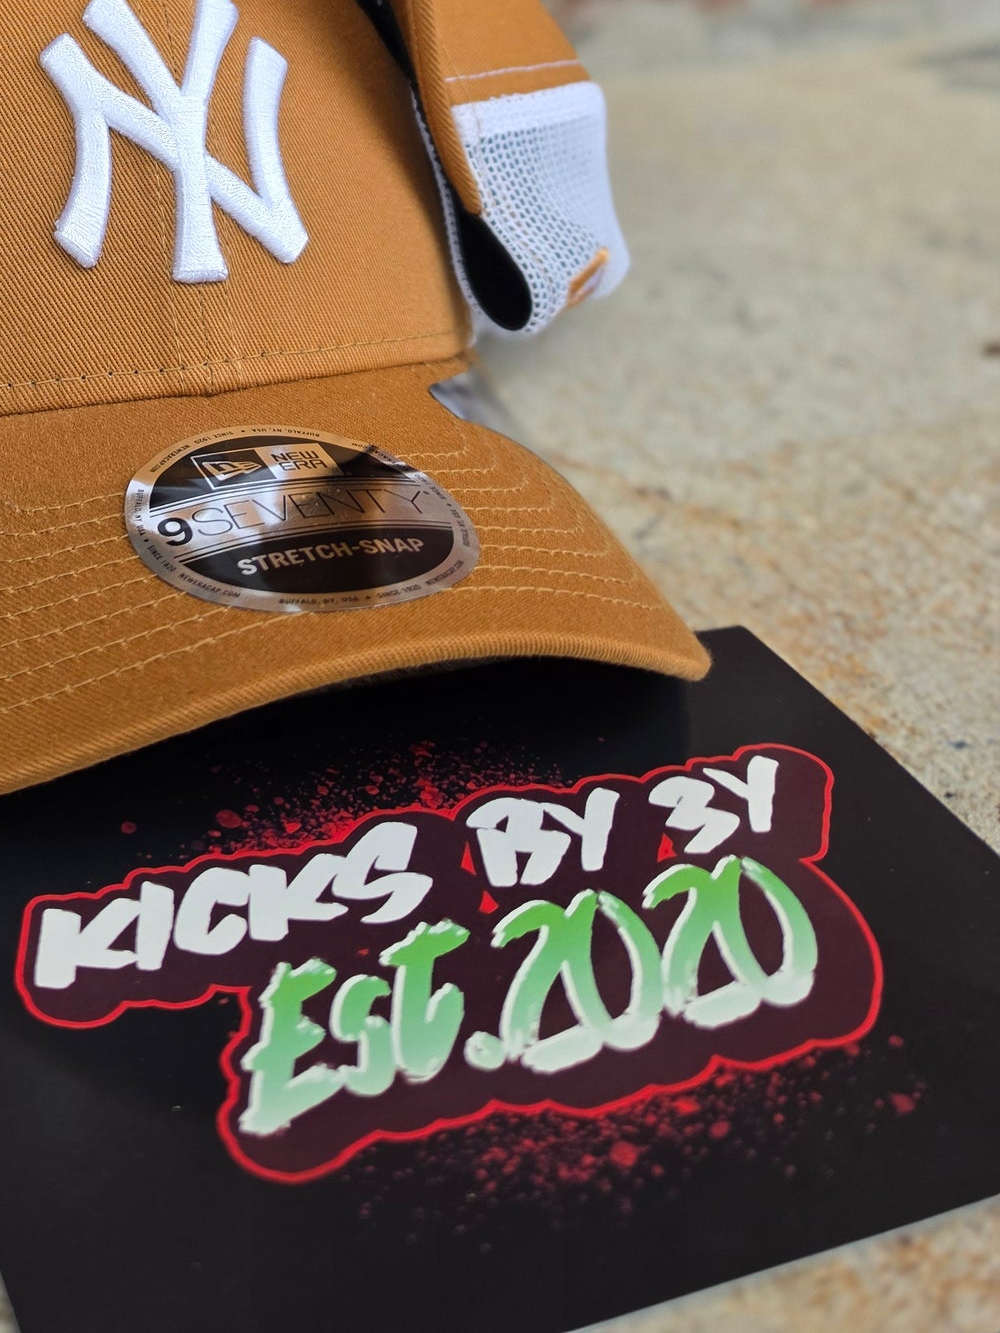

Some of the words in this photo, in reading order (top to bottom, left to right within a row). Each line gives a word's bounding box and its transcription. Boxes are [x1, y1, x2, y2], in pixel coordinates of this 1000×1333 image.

[271, 450, 319, 463] NEW
[279, 459, 328, 471] ERA
[236, 537, 425, 576] STRETCH-SNAP
[34, 821, 433, 989] KICKS
[466, 787, 619, 887] BY
